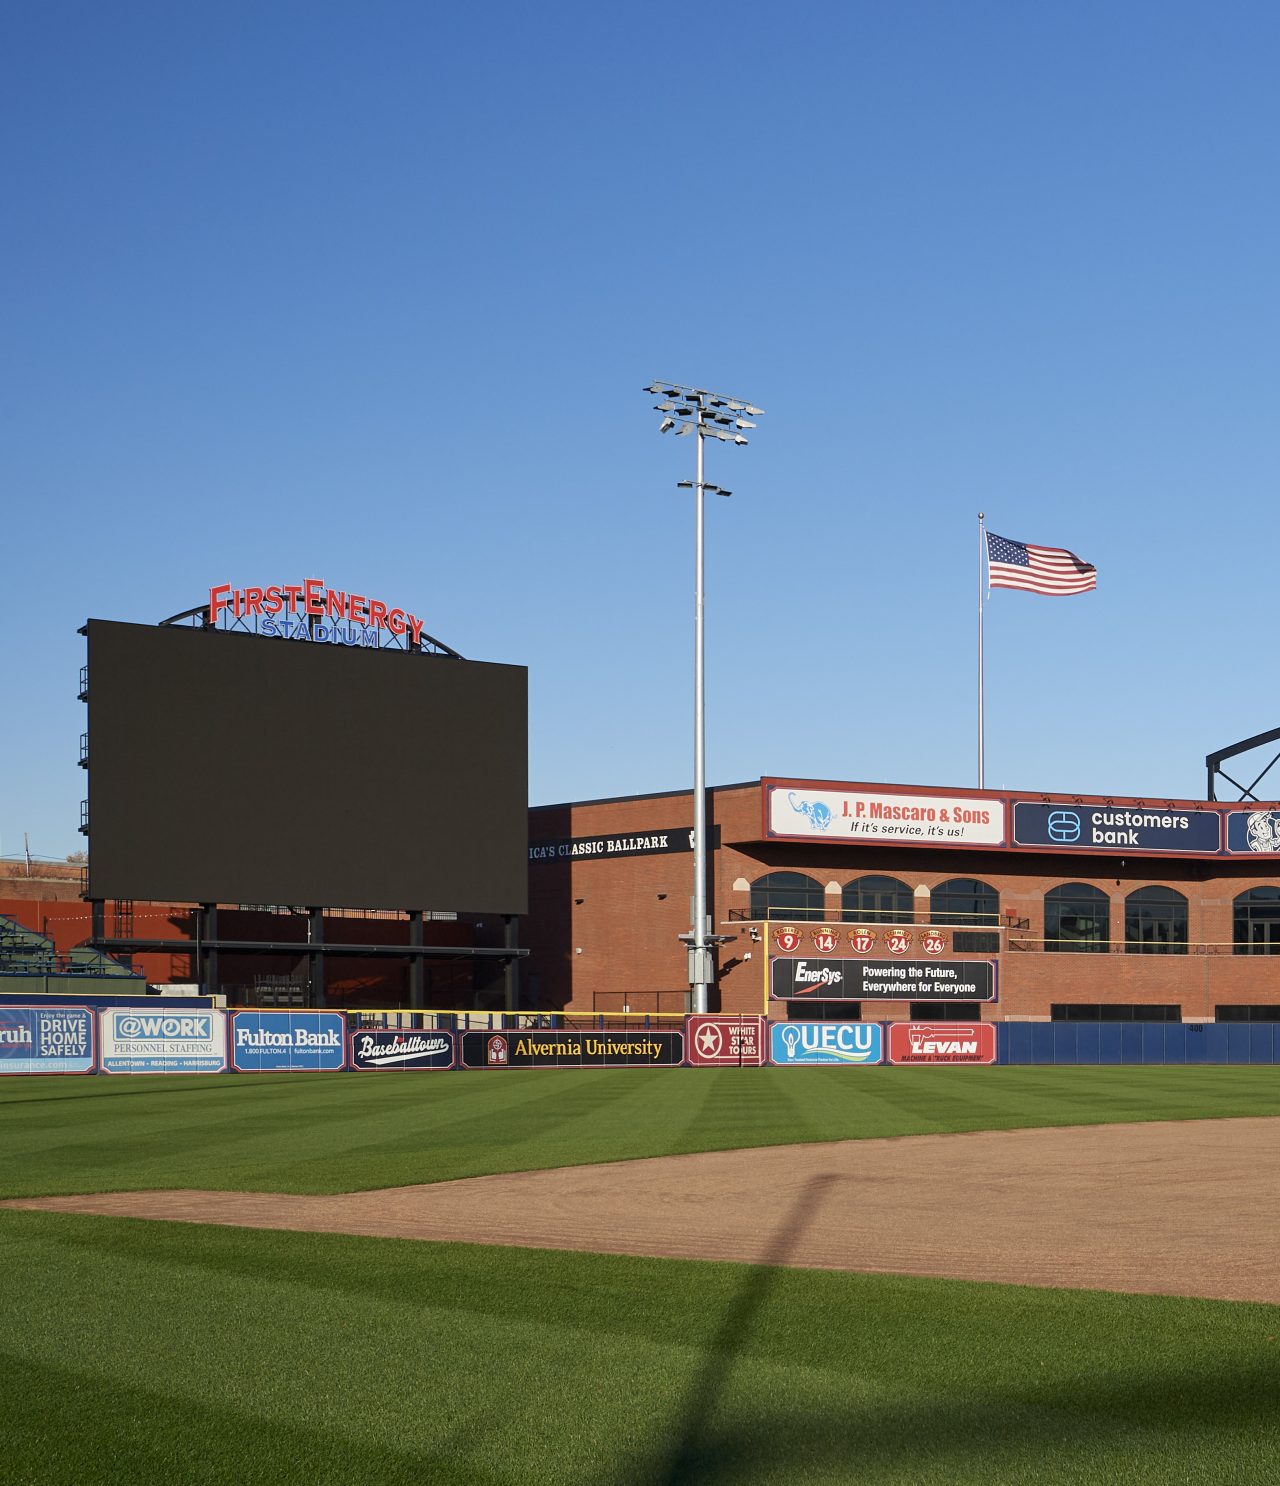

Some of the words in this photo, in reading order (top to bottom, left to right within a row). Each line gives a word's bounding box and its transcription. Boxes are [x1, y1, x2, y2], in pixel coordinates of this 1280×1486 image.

[209, 578, 424, 645] FIRSTENERGY
[260, 618, 380, 649] STADIUM
[842, 801, 852, 818] J.
[855, 802, 866, 818] P.
[870, 802, 936, 822] Mascaro
[939, 808, 950, 822] &
[953, 807, 990, 825] Sons
[1092, 812, 1189, 829] customers
[850, 822, 861, 832] If
[861, 823, 878, 833] it's
[882, 825, 924, 836] service,
[928, 826, 944, 836] it's
[947, 828, 965, 837] us!
[1092, 827, 1139, 845] bank
[558, 841, 604, 857] CLASSIC
[606, 835, 669, 852] BALLPARK
[784, 935, 794, 949] 9
[818, 936, 833, 949] 14
[856, 937, 870, 950] 17
[891, 938, 906, 951] 24
[926, 939, 942, 951] 26
[795, 962, 842, 985] EnerSys
[862, 966, 906, 980] Powering
[908, 966, 923, 978] the
[925, 967, 958, 979] Future,
[862, 981, 917, 993] Everywhere
[918, 981, 931, 992] for
[934, 982, 976, 994] Everyone
[40, 1012, 55, 1020] Enjoy
[41, 1019, 87, 1032] DRIVE
[119, 1017, 208, 1037] @WORK
[728, 1027, 756, 1035] WHITE
[41, 1032, 87, 1045] HOME
[236, 1028, 293, 1046] Fulton
[294, 1028, 341, 1046] Bank
[731, 1036, 754, 1045] STAR
[801, 1025, 872, 1050] UECU
[41, 1045, 87, 1056] SAFELY
[114, 1043, 167, 1053] PERSONNEL
[169, 1043, 212, 1053] STAFFING
[358, 1035, 447, 1059] Baseballtown
[514, 1039, 581, 1056] Alvernia
[585, 1039, 663, 1059] University
[728, 1046, 757, 1055] TOURS
[911, 1041, 978, 1053] LEVAN
